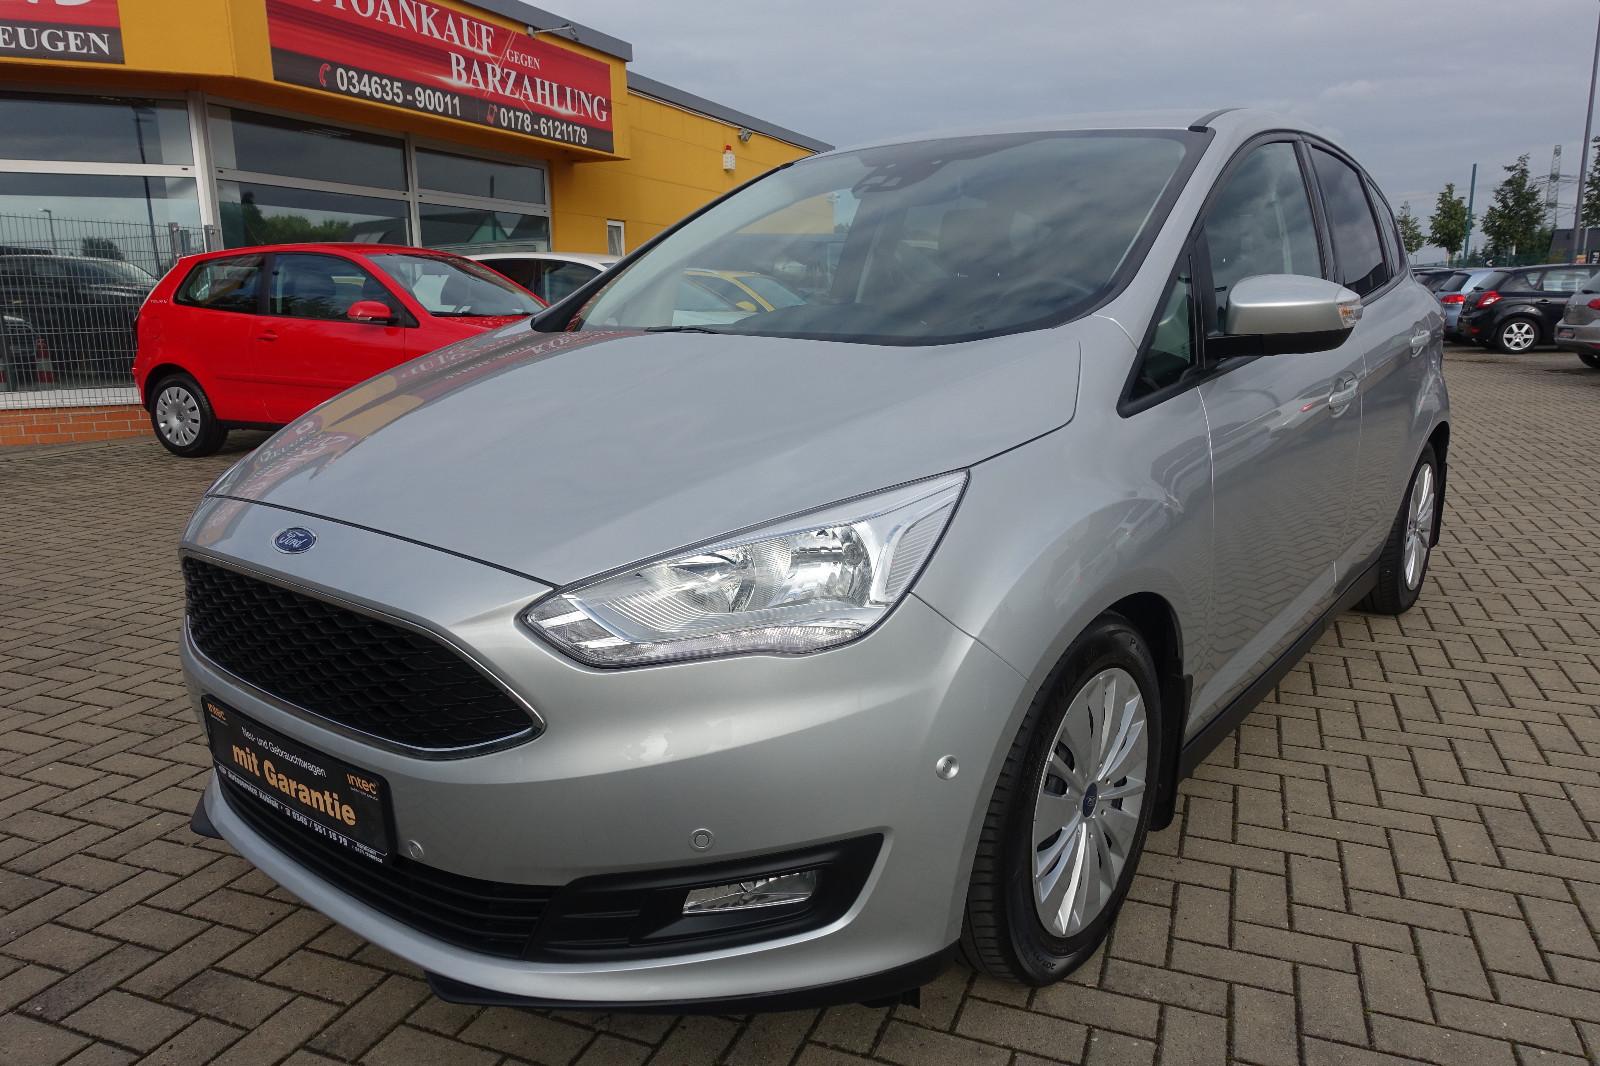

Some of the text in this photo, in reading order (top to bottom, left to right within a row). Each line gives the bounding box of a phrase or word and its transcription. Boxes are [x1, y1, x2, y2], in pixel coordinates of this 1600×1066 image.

[0, 26, 110, 55] EUGEN
[506, 49, 541, 70] GEGEN
[448, 51, 608, 122] BARZAHLUNG
[279, 531, 308, 548] Ford
[257, 738, 269, 750] und
[232, 744, 356, 826] mit Garantie
